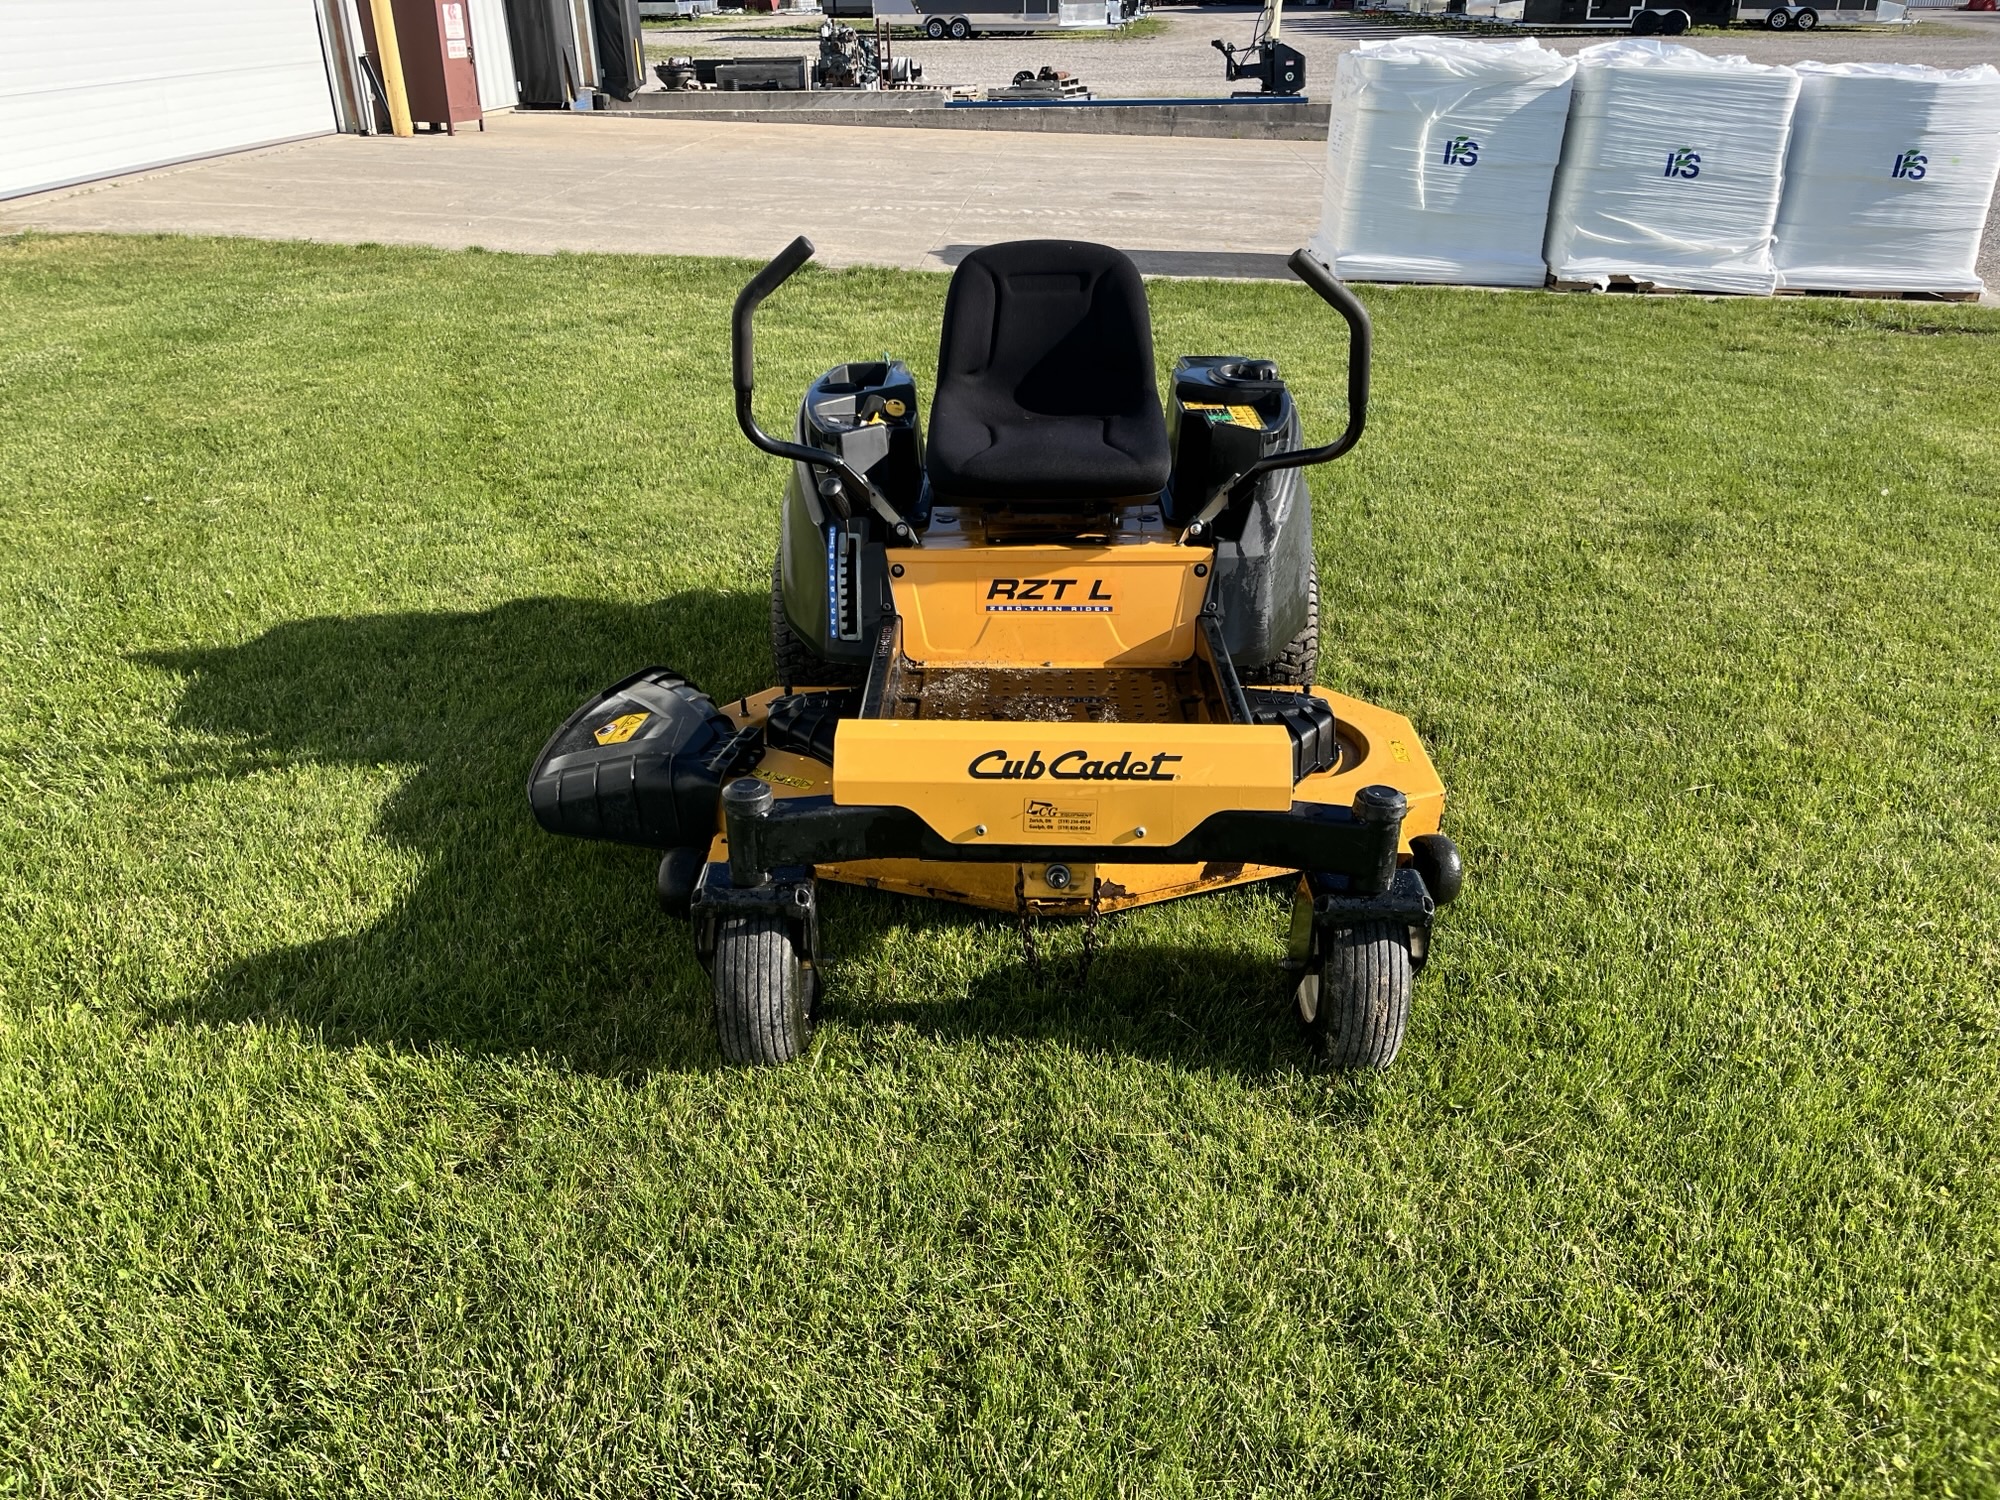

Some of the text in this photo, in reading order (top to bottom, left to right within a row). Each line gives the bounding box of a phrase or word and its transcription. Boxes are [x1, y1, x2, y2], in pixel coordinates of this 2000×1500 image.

[986, 578, 1113, 601] RZT L
[968, 749, 1183, 781] Cub Cadet
